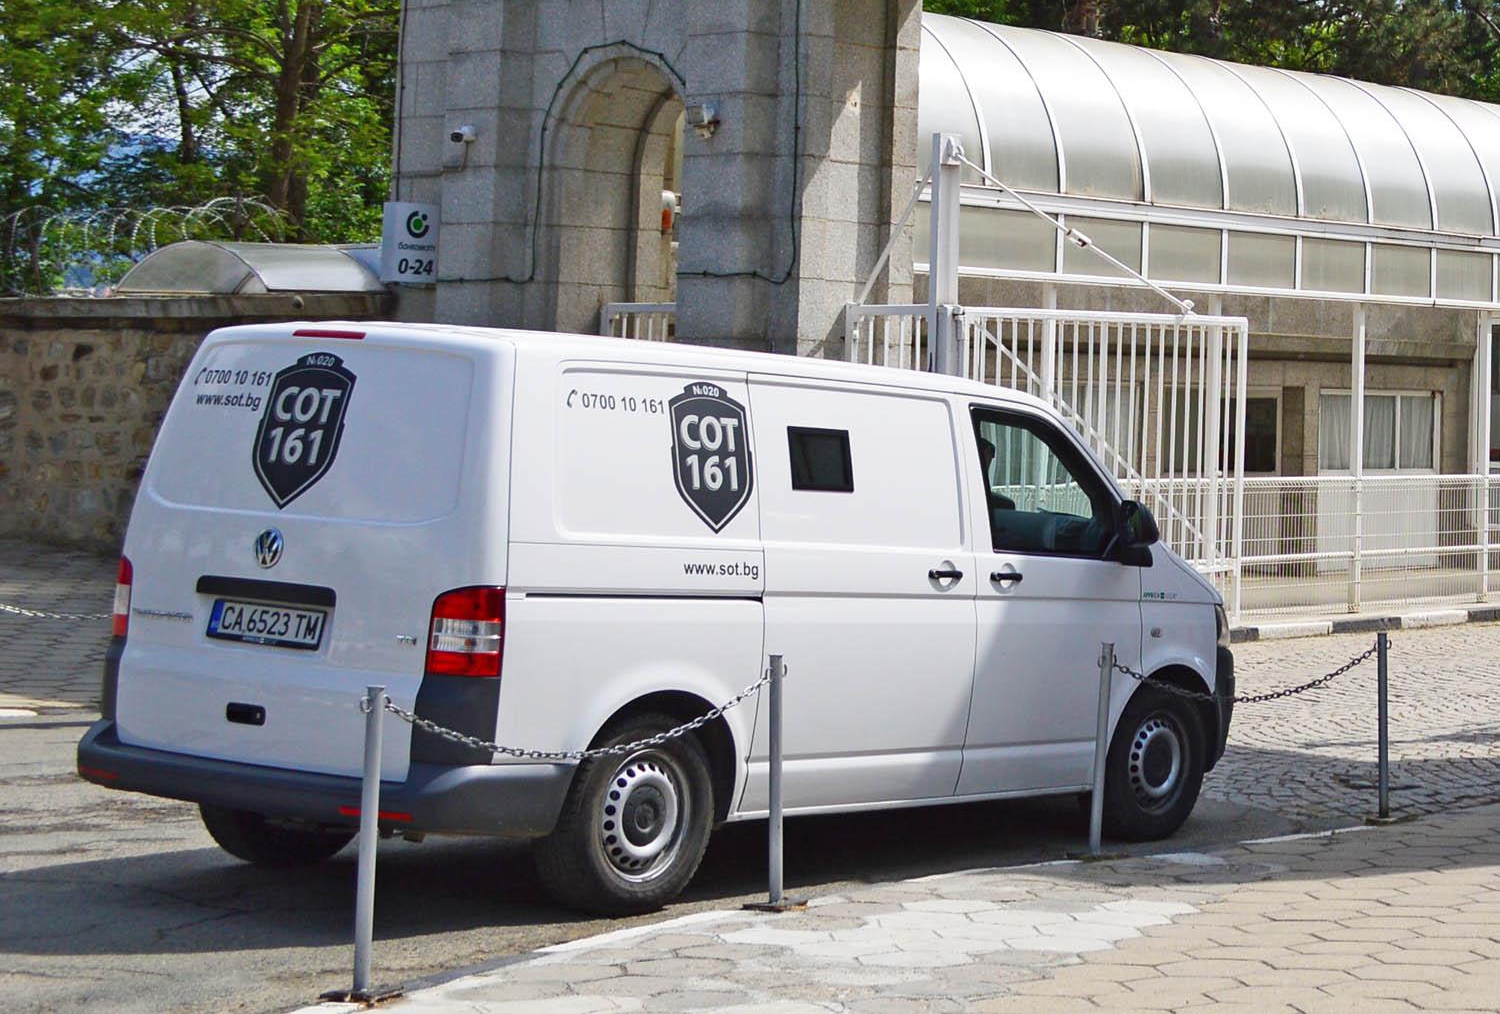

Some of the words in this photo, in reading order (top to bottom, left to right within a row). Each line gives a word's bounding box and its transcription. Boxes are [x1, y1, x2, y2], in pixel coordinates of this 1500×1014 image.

[398, 258, 434, 276] 0-24
[204, 369, 232, 385] 0700
[235, 370, 246, 385] 10
[251, 371, 272, 387] 161
[196, 392, 262, 412] www.sot.bg
[582, 393, 616, 410] 0700
[621, 396, 637, 412] 10
[641, 398, 664, 414] 161
[267, 427, 324, 466] 161
[685, 454, 738, 491] 161
[684, 562, 759, 580] www.sot.bg
[221, 606, 244, 631] CA
[246, 609, 291, 636] 6523
[295, 614, 320, 640] TM
